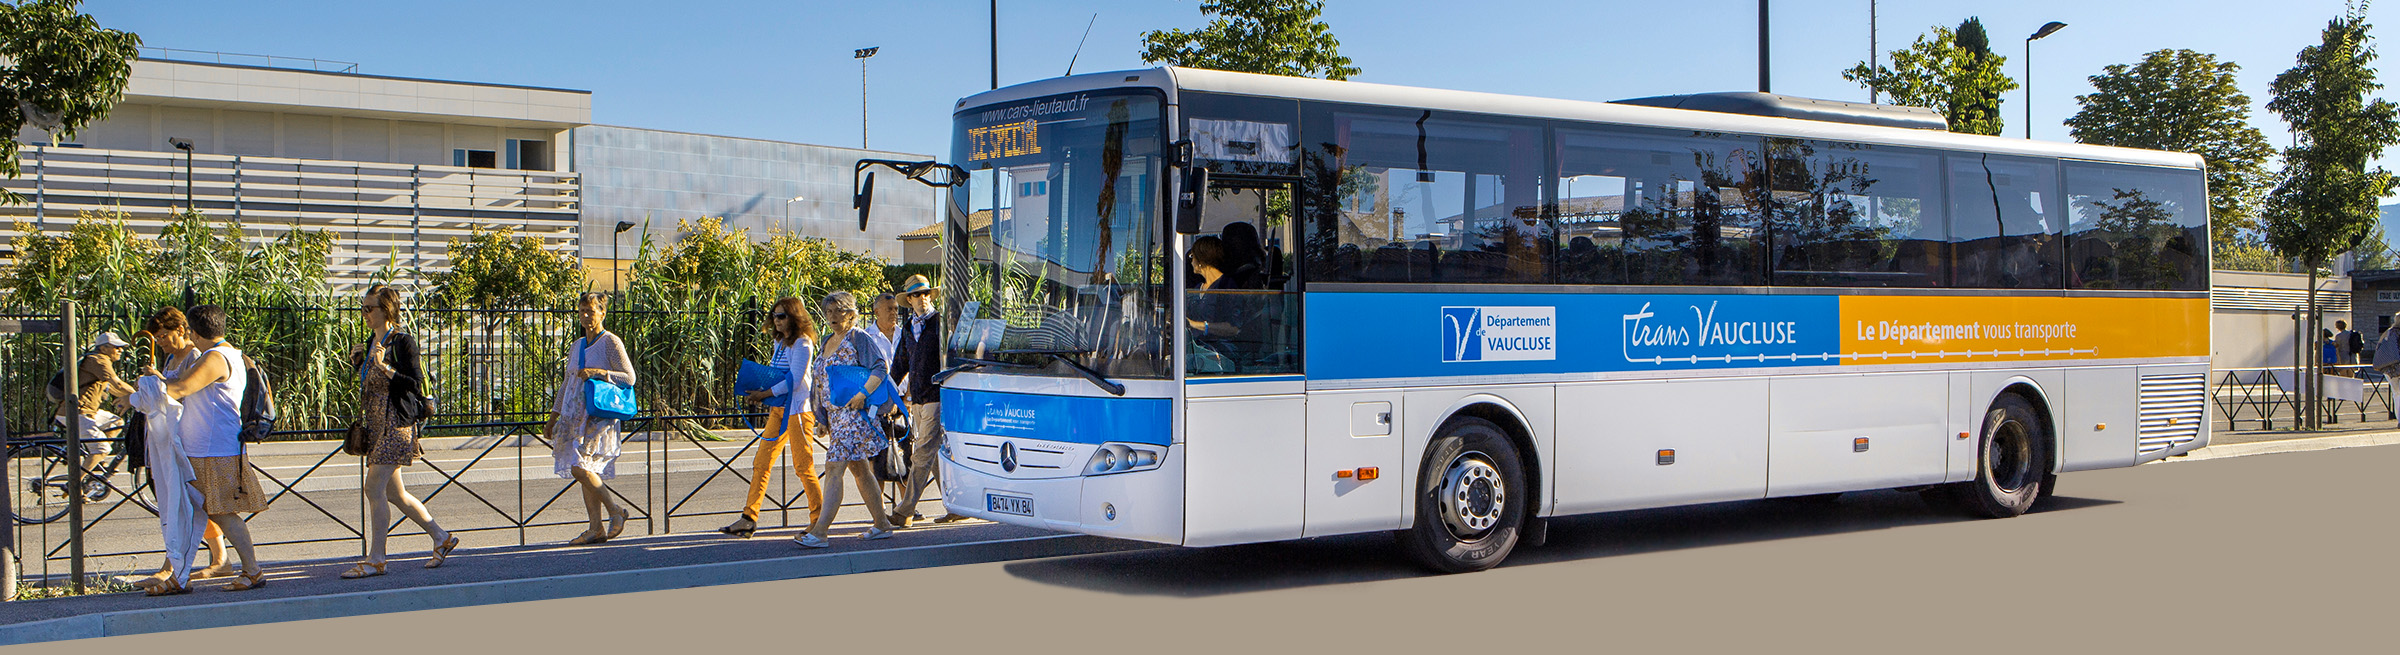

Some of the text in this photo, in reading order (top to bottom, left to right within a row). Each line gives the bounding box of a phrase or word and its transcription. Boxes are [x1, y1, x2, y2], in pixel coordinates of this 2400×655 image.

[982, 94, 1089, 123] www.cars-lieutaud.fr
[1487, 315, 1550, 330] Département
[1623, 300, 1796, 347] trans VAUCLUSE
[1476, 328, 1486, 336] de
[1857, 320, 2077, 346] Le Département vous transporte
[1488, 337, 1550, 351] VAUCLUSE
[1003, 401, 1036, 419] VAUCLUSE
[992, 496, 1031, 514] 8474 YX 84
